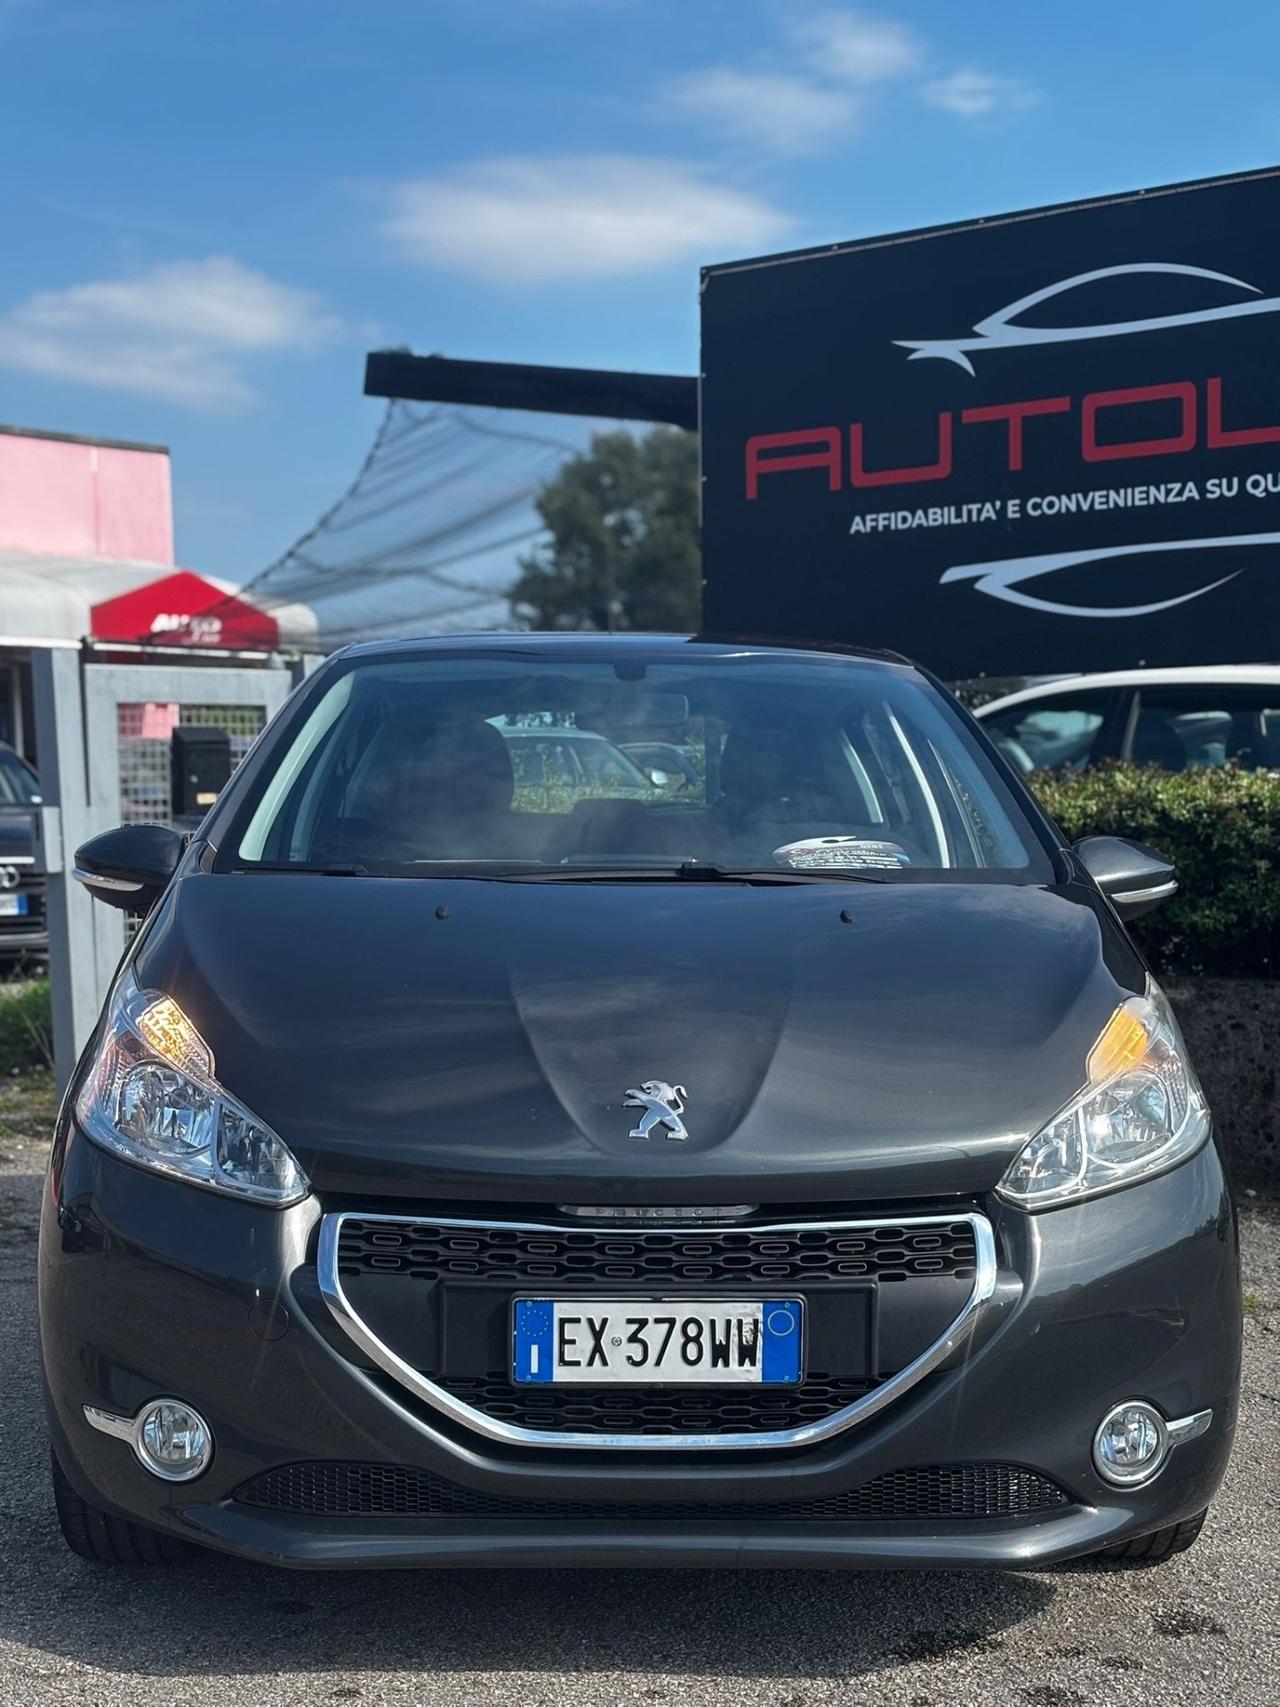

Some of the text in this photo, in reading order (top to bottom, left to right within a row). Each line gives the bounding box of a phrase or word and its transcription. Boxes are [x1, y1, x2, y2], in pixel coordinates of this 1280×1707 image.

[745, 377, 1280, 499] AUTOL
[850, 501, 1001, 534] AFFIDABILITA'
[1007, 500, 1021, 518] E
[1026, 482, 1200, 517] CONVENIENZA
[1205, 477, 1239, 499] SU
